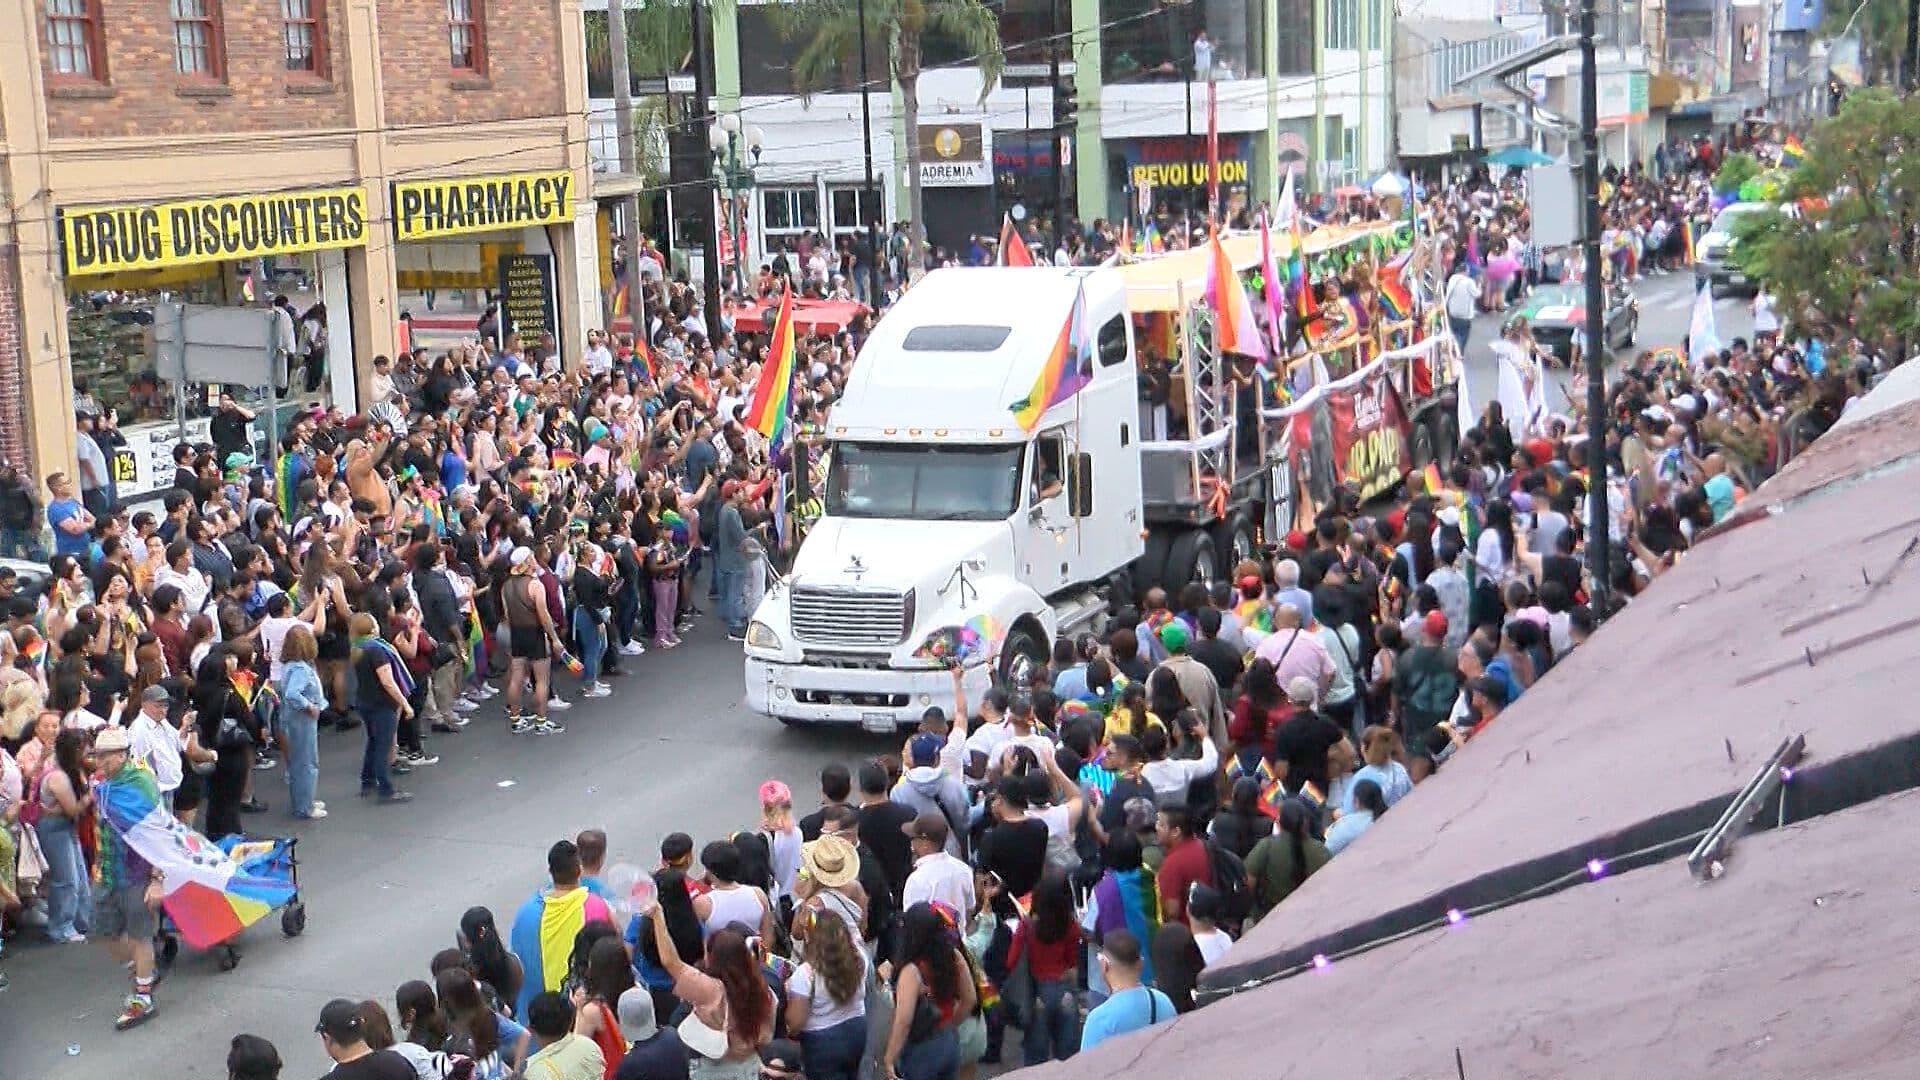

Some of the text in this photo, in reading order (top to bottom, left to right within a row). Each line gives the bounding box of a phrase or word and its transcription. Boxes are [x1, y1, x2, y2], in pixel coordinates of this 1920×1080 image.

[73, 193, 363, 267] DRUG DISCOUNTERS
[402, 176, 569, 233] PHARMACY
